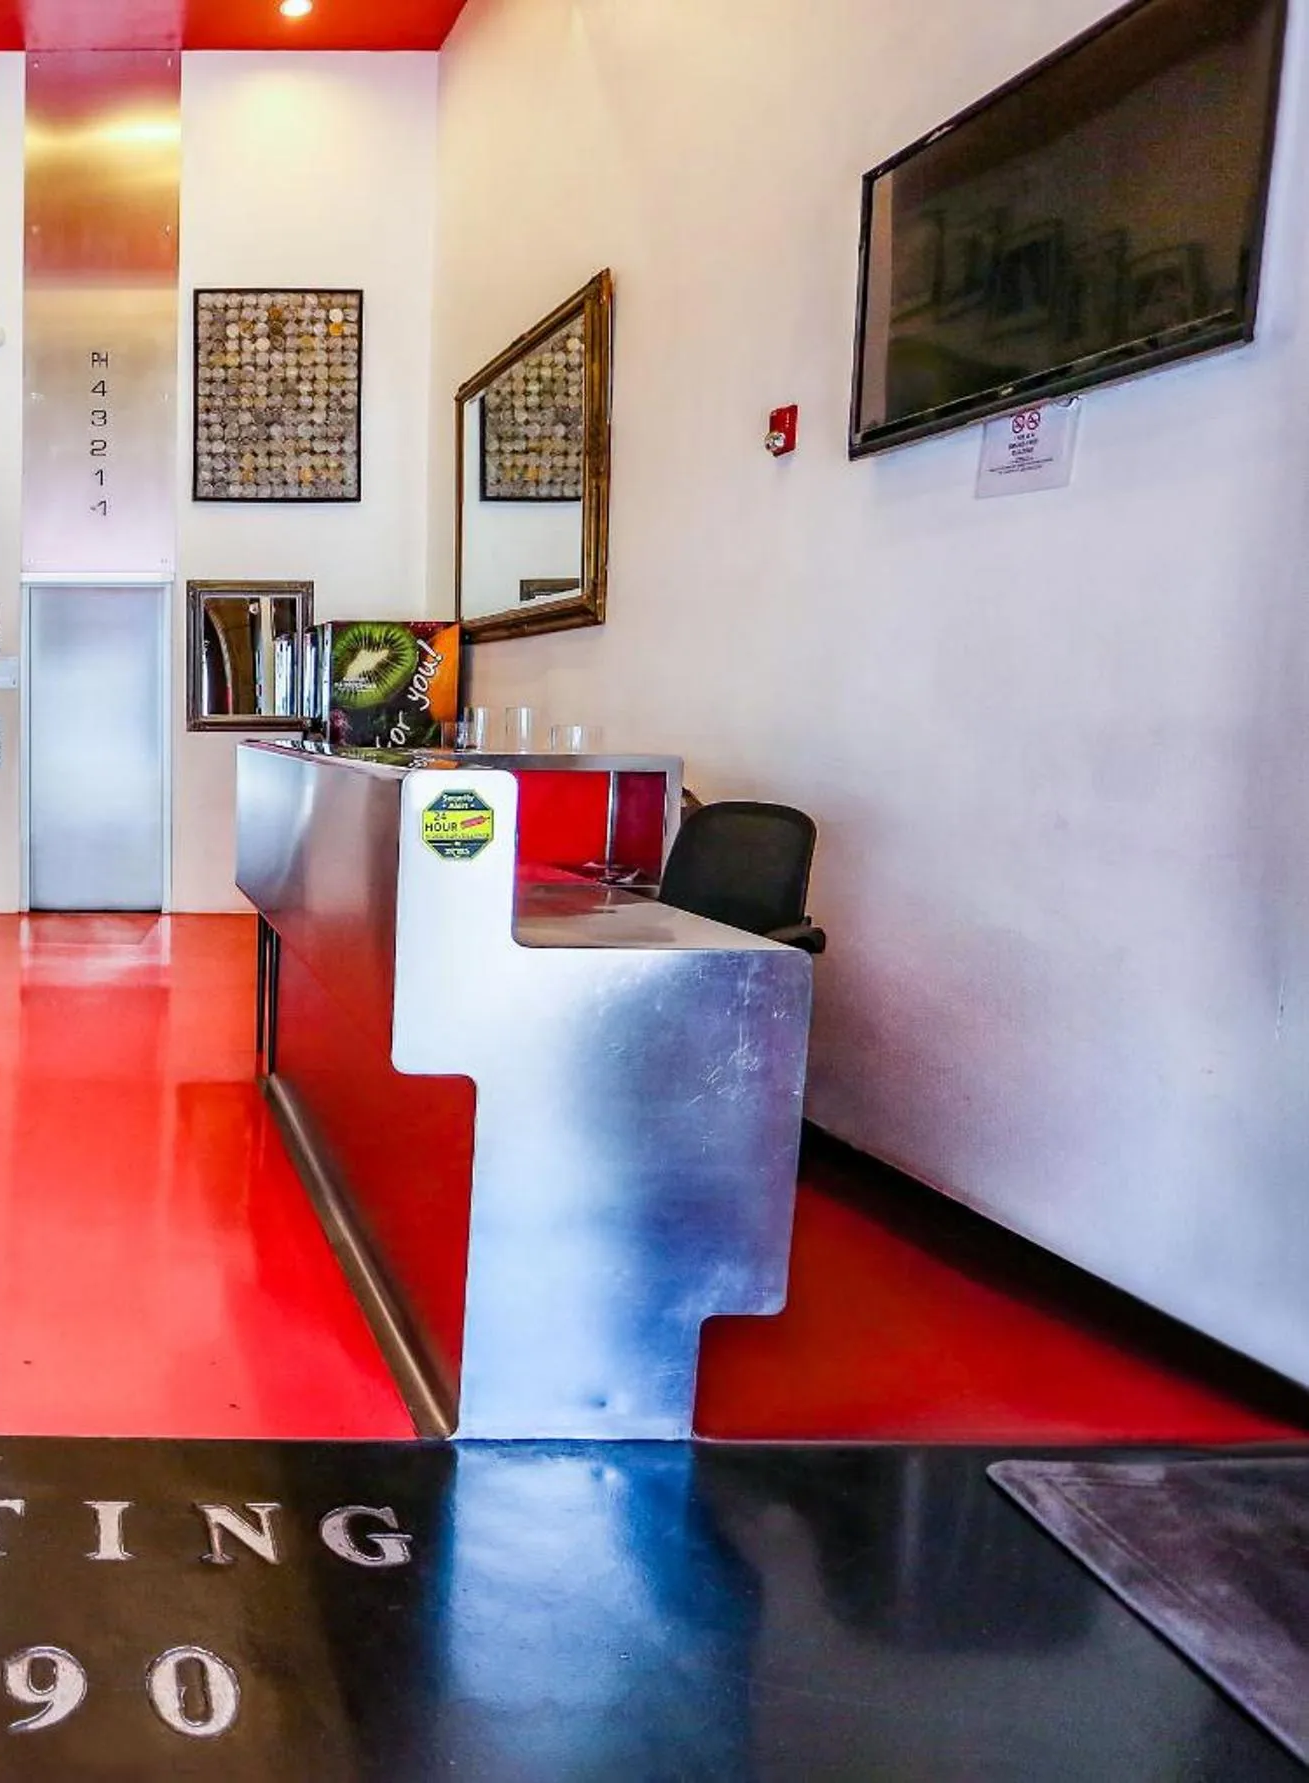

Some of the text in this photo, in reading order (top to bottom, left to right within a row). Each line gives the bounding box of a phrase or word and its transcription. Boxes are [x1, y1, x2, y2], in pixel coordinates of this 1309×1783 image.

[91, 380, 107, 396] 4
[91, 410, 107, 427] 3
[90, 439, 107, 456] 2
[94, 469, 104, 486] 1
[406, 638, 443, 711] you!
[425, 822, 458, 832] HOUR
